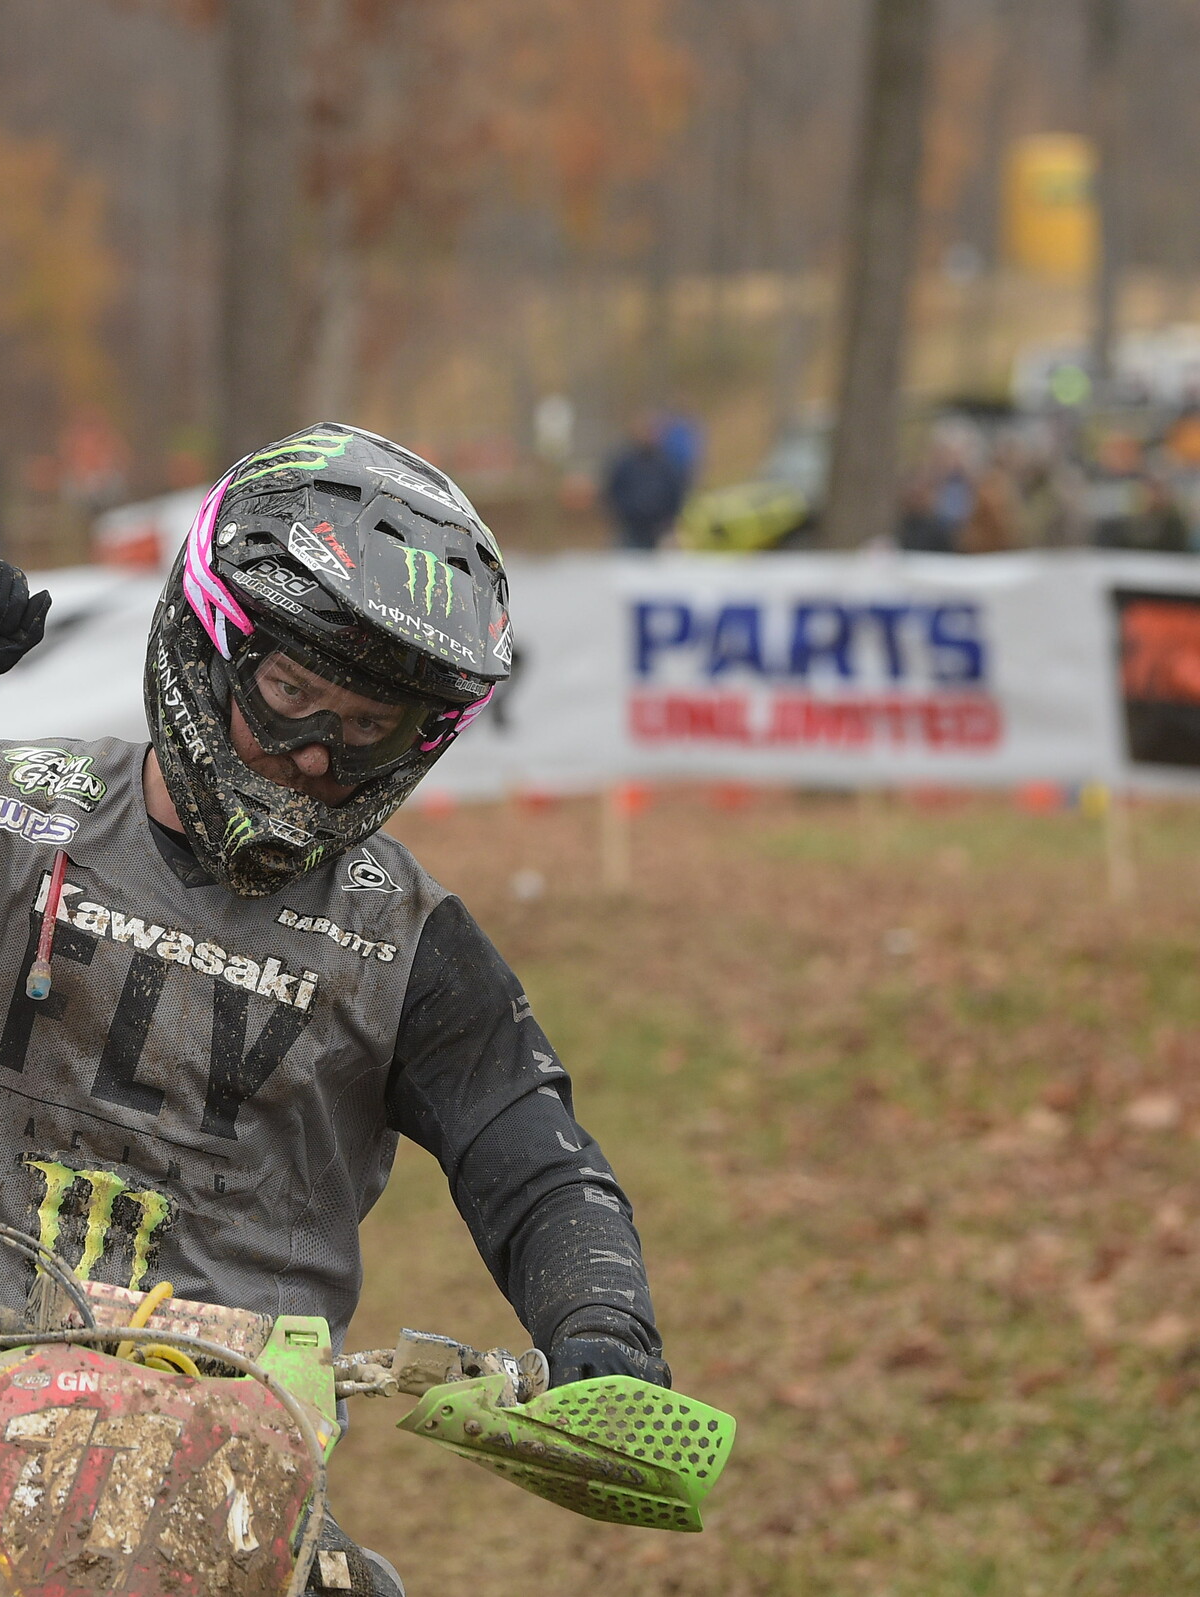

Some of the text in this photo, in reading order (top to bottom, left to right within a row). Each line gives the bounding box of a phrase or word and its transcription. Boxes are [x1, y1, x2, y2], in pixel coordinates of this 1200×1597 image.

[289, 543, 318, 569] RACING
[232, 570, 304, 614] apdesigns
[368, 599, 477, 664] MONSTER
[385, 620, 461, 662] ENERGY
[631, 600, 986, 682] PARTS
[628, 694, 1004, 747] UNLIMITED
[4, 748, 90, 774] TEAM
[13, 763, 102, 796] GREEN
[34, 875, 319, 1010] Kawasaki
